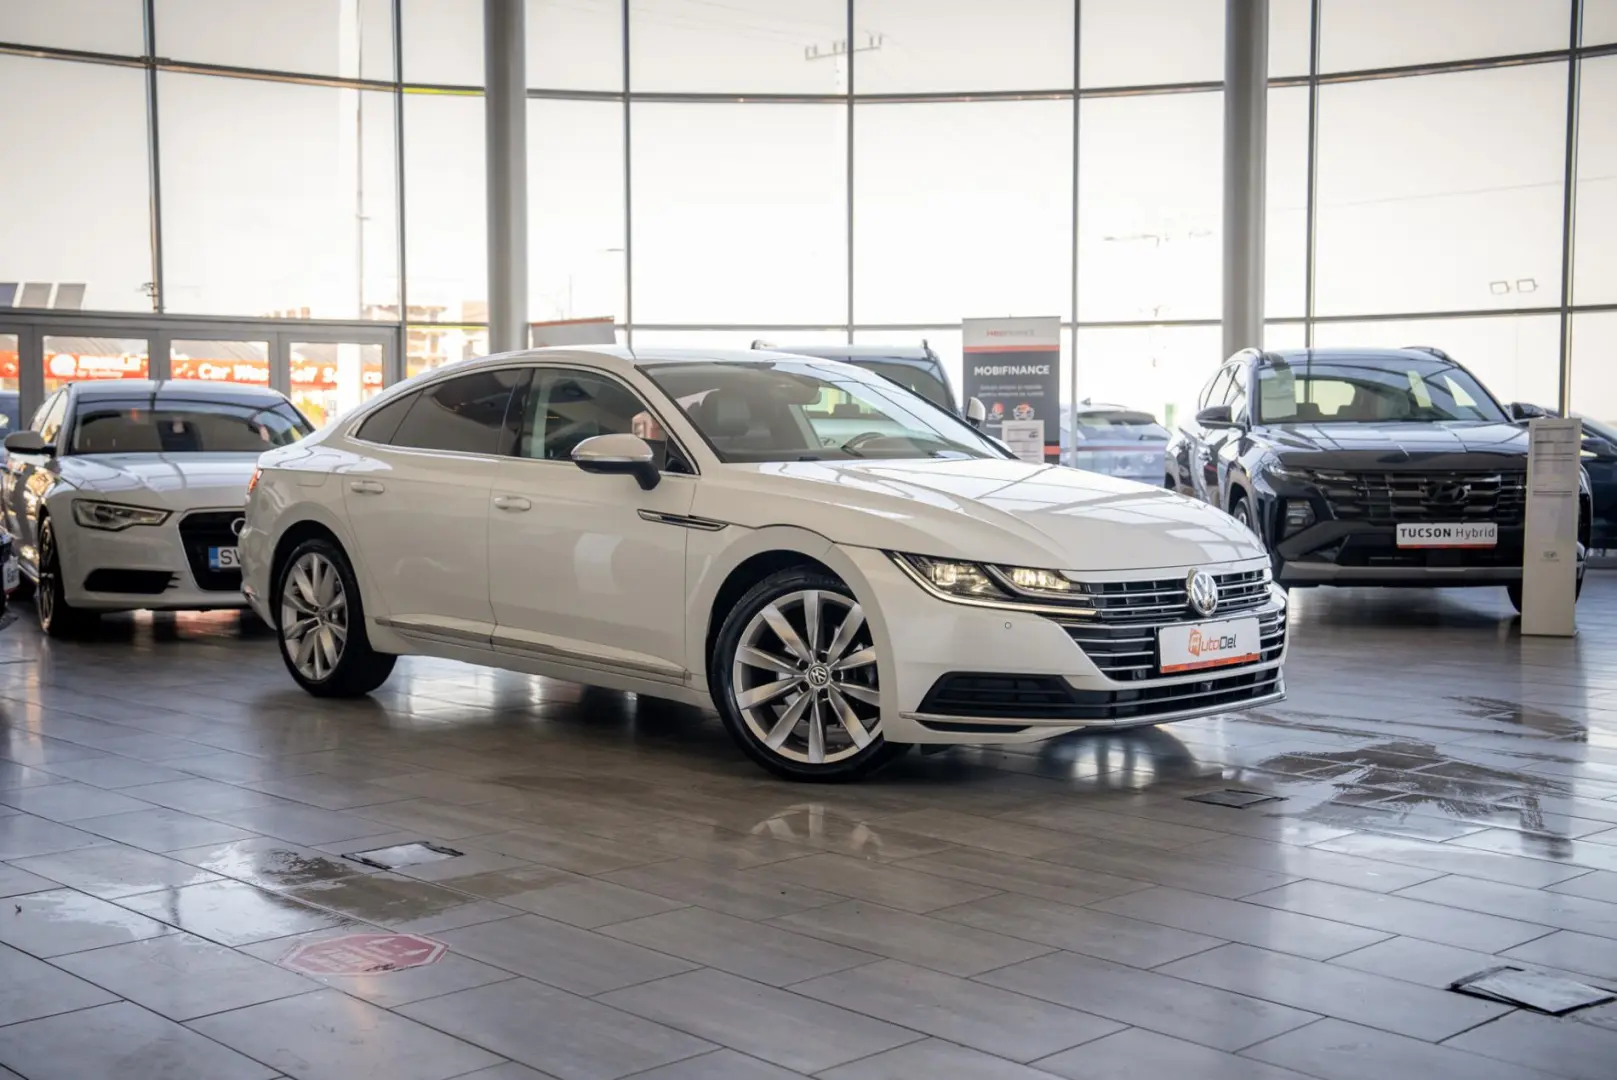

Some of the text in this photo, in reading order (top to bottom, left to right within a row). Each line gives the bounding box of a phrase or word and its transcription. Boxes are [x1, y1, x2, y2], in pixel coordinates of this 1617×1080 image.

[198, 363, 231, 380] Car
[973, 364, 1050, 376] MOBIFINANCE
[1400, 526, 1495, 540] TUCSON Hybrid
